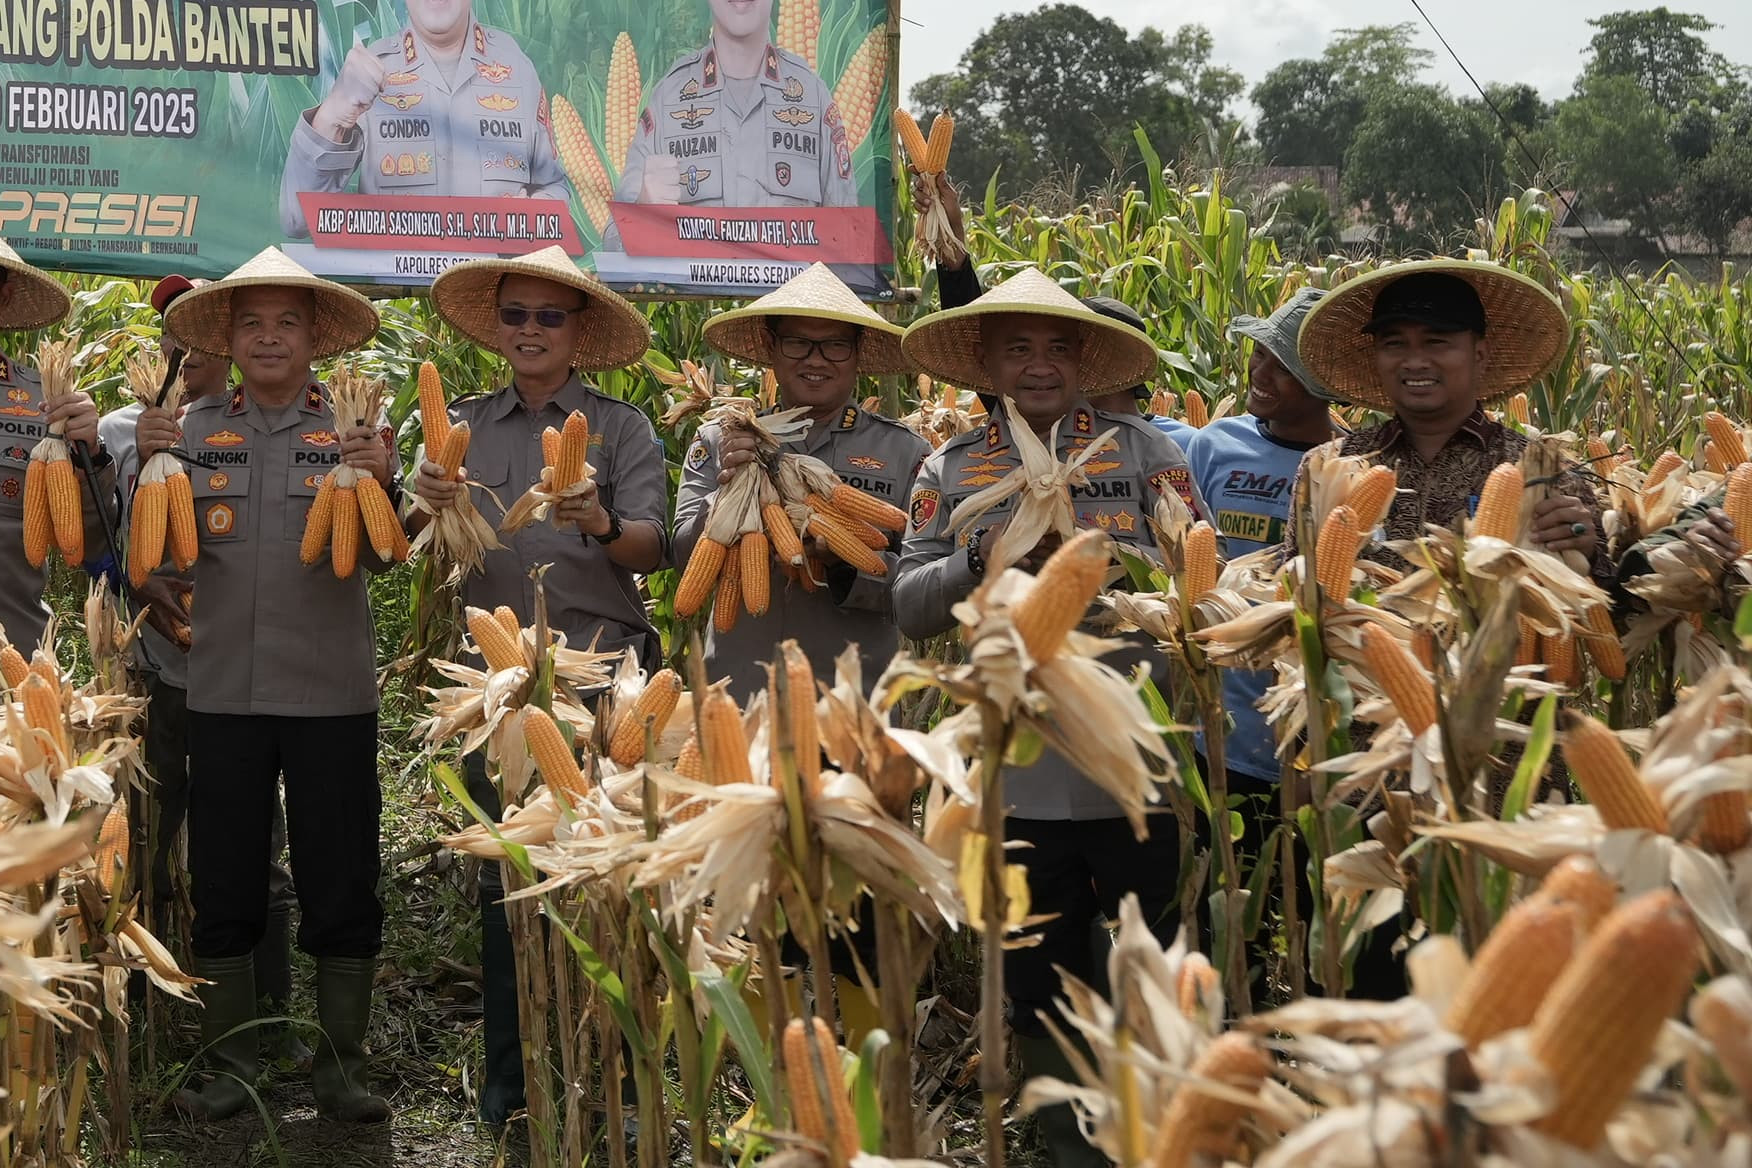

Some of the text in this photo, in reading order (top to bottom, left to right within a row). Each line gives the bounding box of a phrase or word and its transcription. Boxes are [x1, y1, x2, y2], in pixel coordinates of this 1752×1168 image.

[183, 1, 315, 70] BANTEN
[7, 89, 125, 133] FEBRUARI
[133, 93, 197, 135] 2025
[380, 118, 431, 139] CONDRO
[479, 119, 522, 138] POLRI
[669, 136, 717, 159] FAUZAN
[772, 132, 816, 156] POLRI
[50, 168, 86, 188] POLRI
[88, 170, 120, 188] YANG
[317, 209, 562, 241] AKBP CANDRA SASONGKO, S.H., S.I.K., M.H., M.SI.
[677, 217, 818, 248] KOMPOL FAUZAN AFIFI, S.I.K.
[150, 242, 198, 256] BERKEADILAN
[395, 256, 448, 274] KAPOLRES
[690, 264, 760, 283] WAKAPOLRES
[197, 451, 248, 464] HENGKI
[296, 452, 341, 465] POLR
[1151, 470, 1187, 485] POLRES
[1070, 481, 1131, 498] POLRI
[1218, 512, 1265, 536] KONTAF
